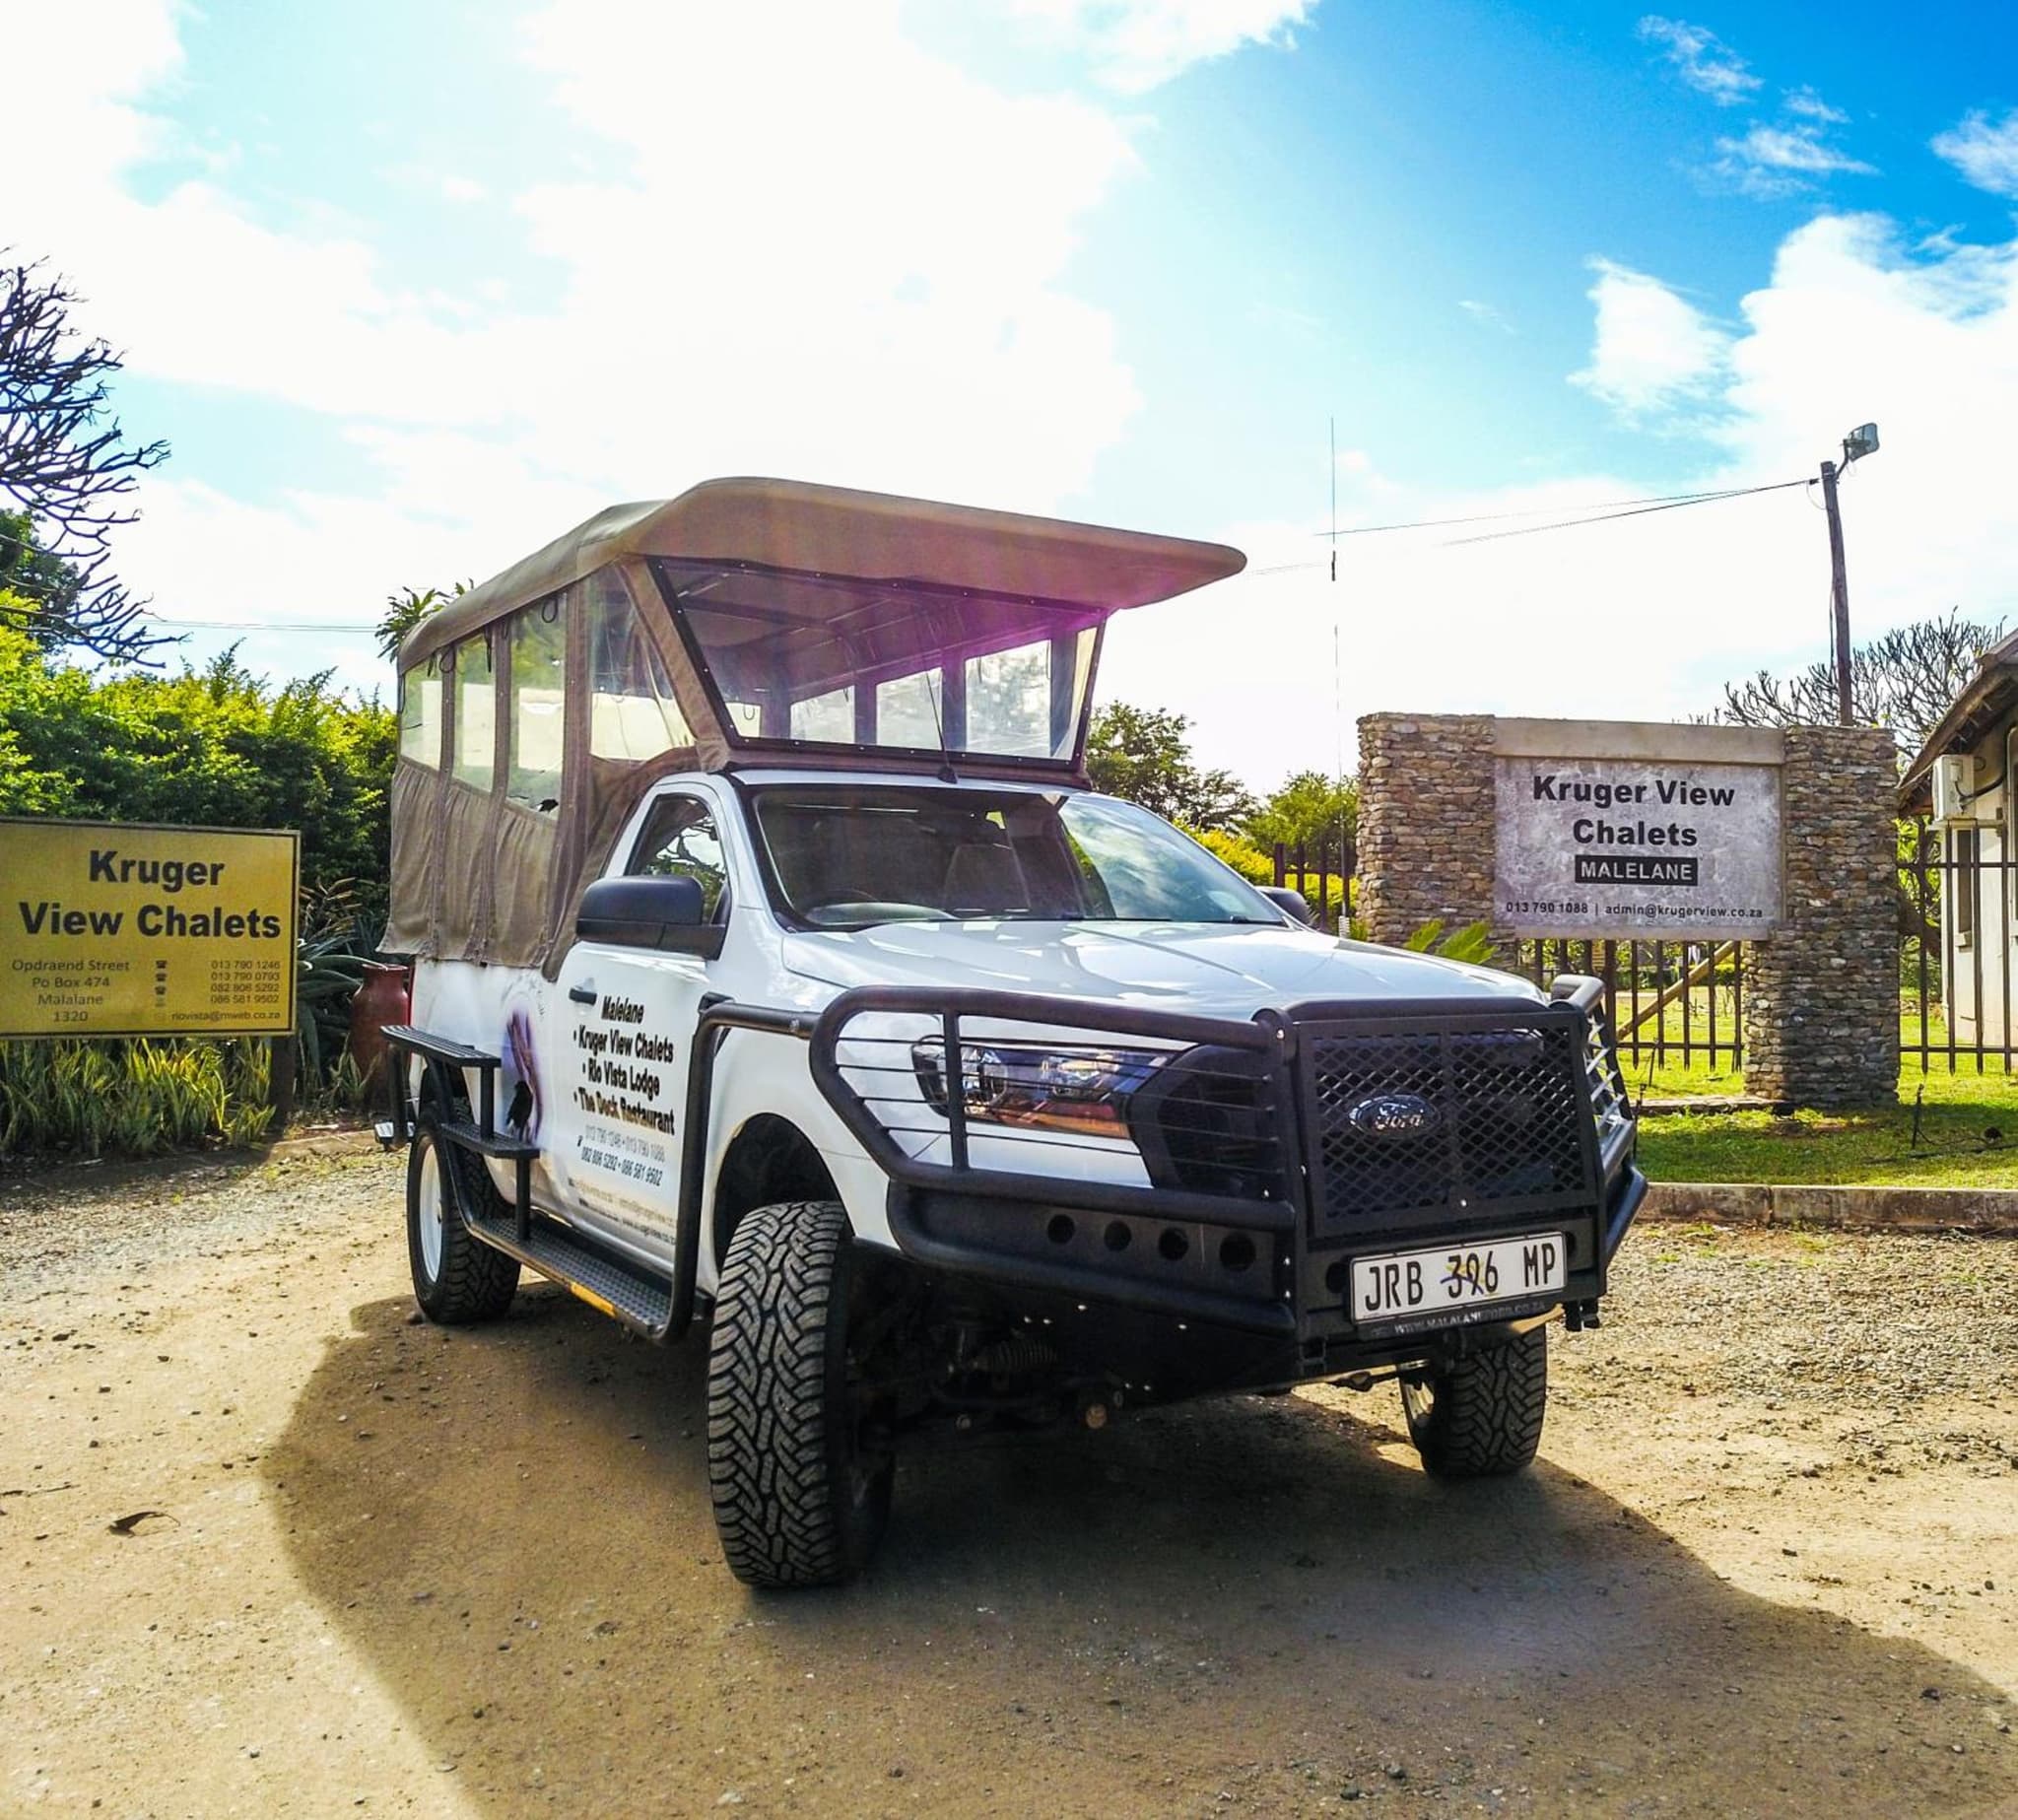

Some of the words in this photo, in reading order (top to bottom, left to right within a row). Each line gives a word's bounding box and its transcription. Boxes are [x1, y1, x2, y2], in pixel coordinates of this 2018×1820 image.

[1533, 775, 1648, 809] Kruger
[1655, 779, 1735, 806] View
[1573, 819, 1698, 846] Chalets
[89, 849, 225, 893] Kruger
[1581, 861, 1693, 881] MALELANE
[19, 902, 123, 935] View
[137, 904, 281, 938] Chalets
[1506, 902, 1529, 913] 013
[1533, 902, 1555, 913] 790
[1558, 902, 1588, 914] 1088
[1605, 904, 1763, 918] admin@krugerview.co.za
[12, 960, 84, 973] Opdraend
[88, 960, 130, 972] Street
[211, 961, 231, 970] 013
[211, 972, 231, 980] 013
[33, 977, 49, 987] Po
[54, 977, 80, 987] Box
[84, 977, 110, 987] 474
[53, 1011, 89, 1022] 1320
[601, 995, 644, 1024] Malelane
[578, 1025, 608, 1056] Kruger
[610, 1029, 634, 1056] View
[636, 1033, 674, 1063] Chalets
[588, 1057, 602, 1083] Rio
[604, 1061, 627, 1089] Vista
[630, 1065, 660, 1101] Lodge
[578, 1087, 595, 1112] The
[620, 1097, 675, 1135] Restaurant
[1365, 1260, 1423, 1312] JRB
[1446, 1250, 1499, 1299] 396
[1522, 1242, 1556, 1288] MP
